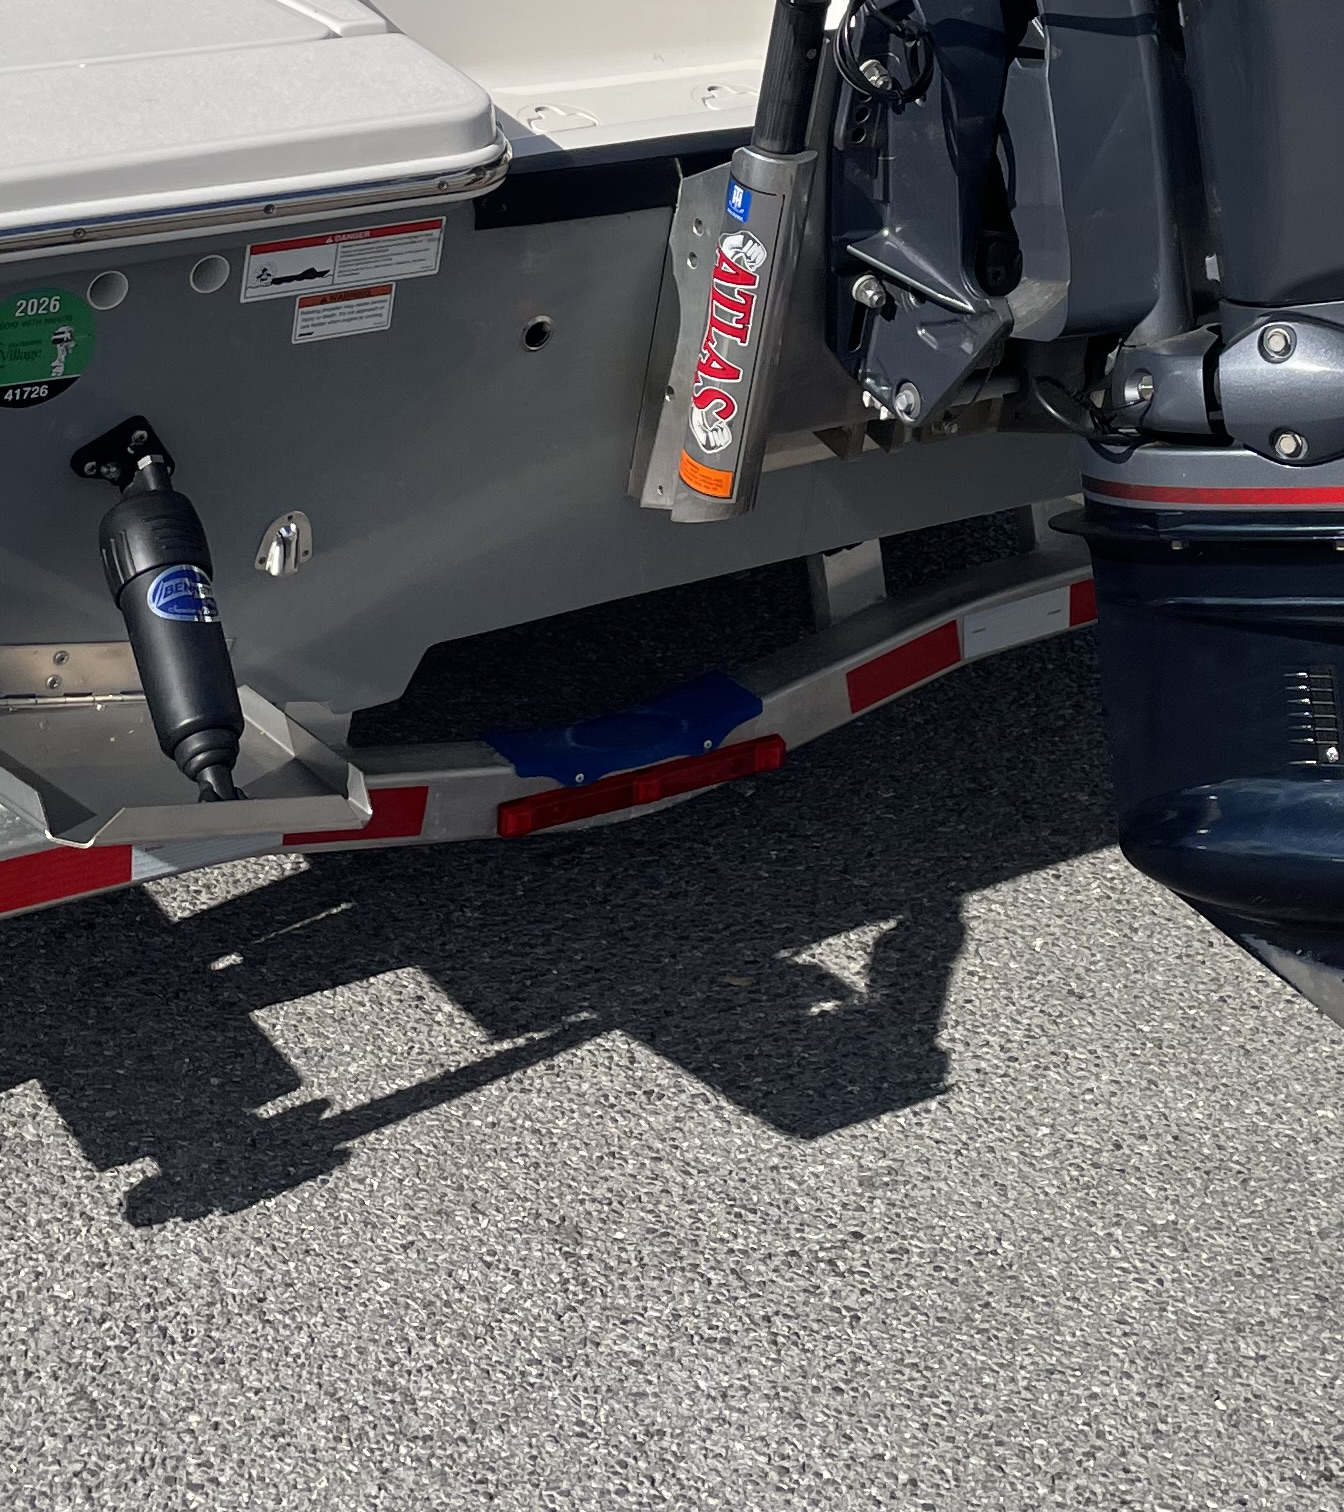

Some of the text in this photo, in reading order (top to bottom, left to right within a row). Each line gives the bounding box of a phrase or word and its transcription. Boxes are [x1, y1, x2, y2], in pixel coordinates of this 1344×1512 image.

[334, 230, 371, 243] DANGER
[15, 295, 61, 317] 2026
[692, 246, 758, 422] ATLAS
[3, 384, 49, 402] 41726
